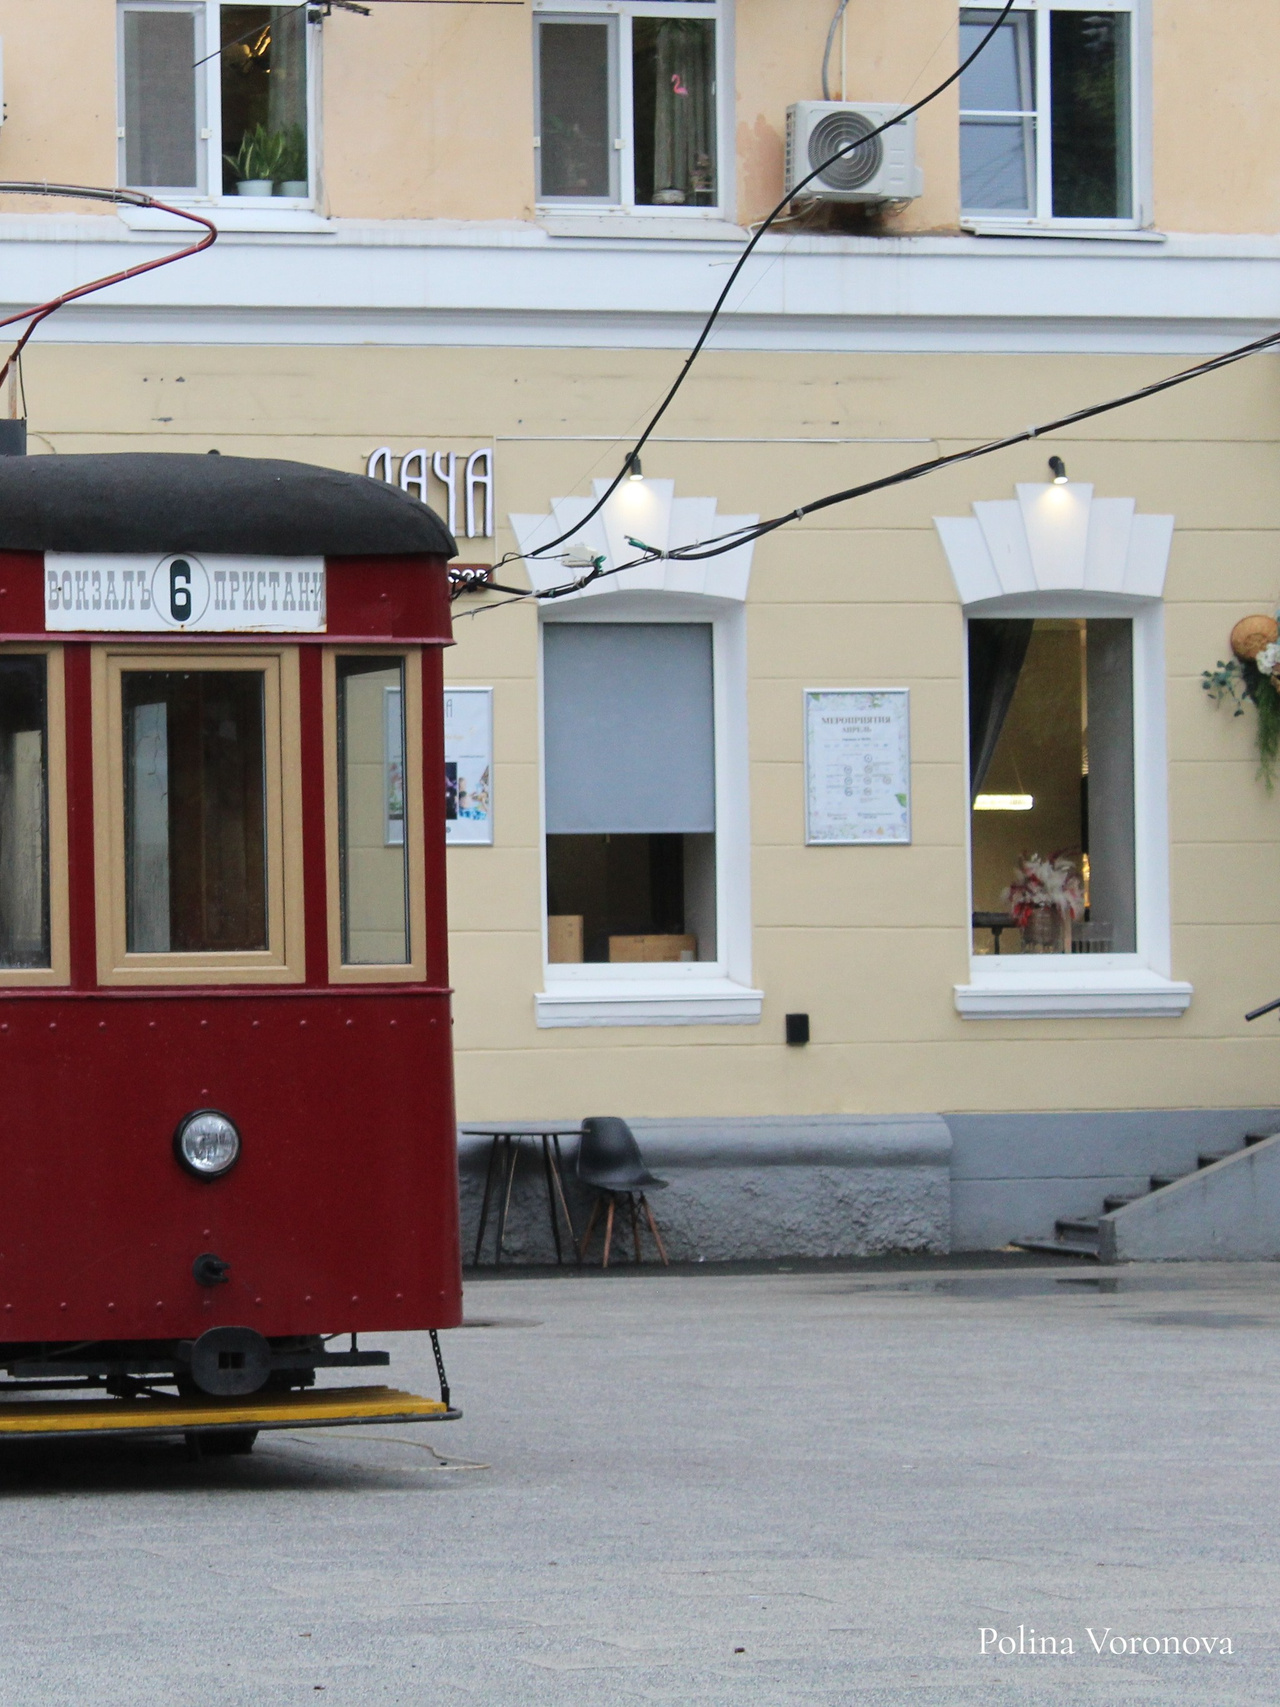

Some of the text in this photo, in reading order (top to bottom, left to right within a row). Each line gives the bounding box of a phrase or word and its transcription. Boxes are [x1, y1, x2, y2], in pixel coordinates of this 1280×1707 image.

[48, 558, 324, 621] ВОКЗАЛЪ 6 ПРИСТАНИ
[821, 716, 891, 725] МЕРОПРИЯТИЯ
